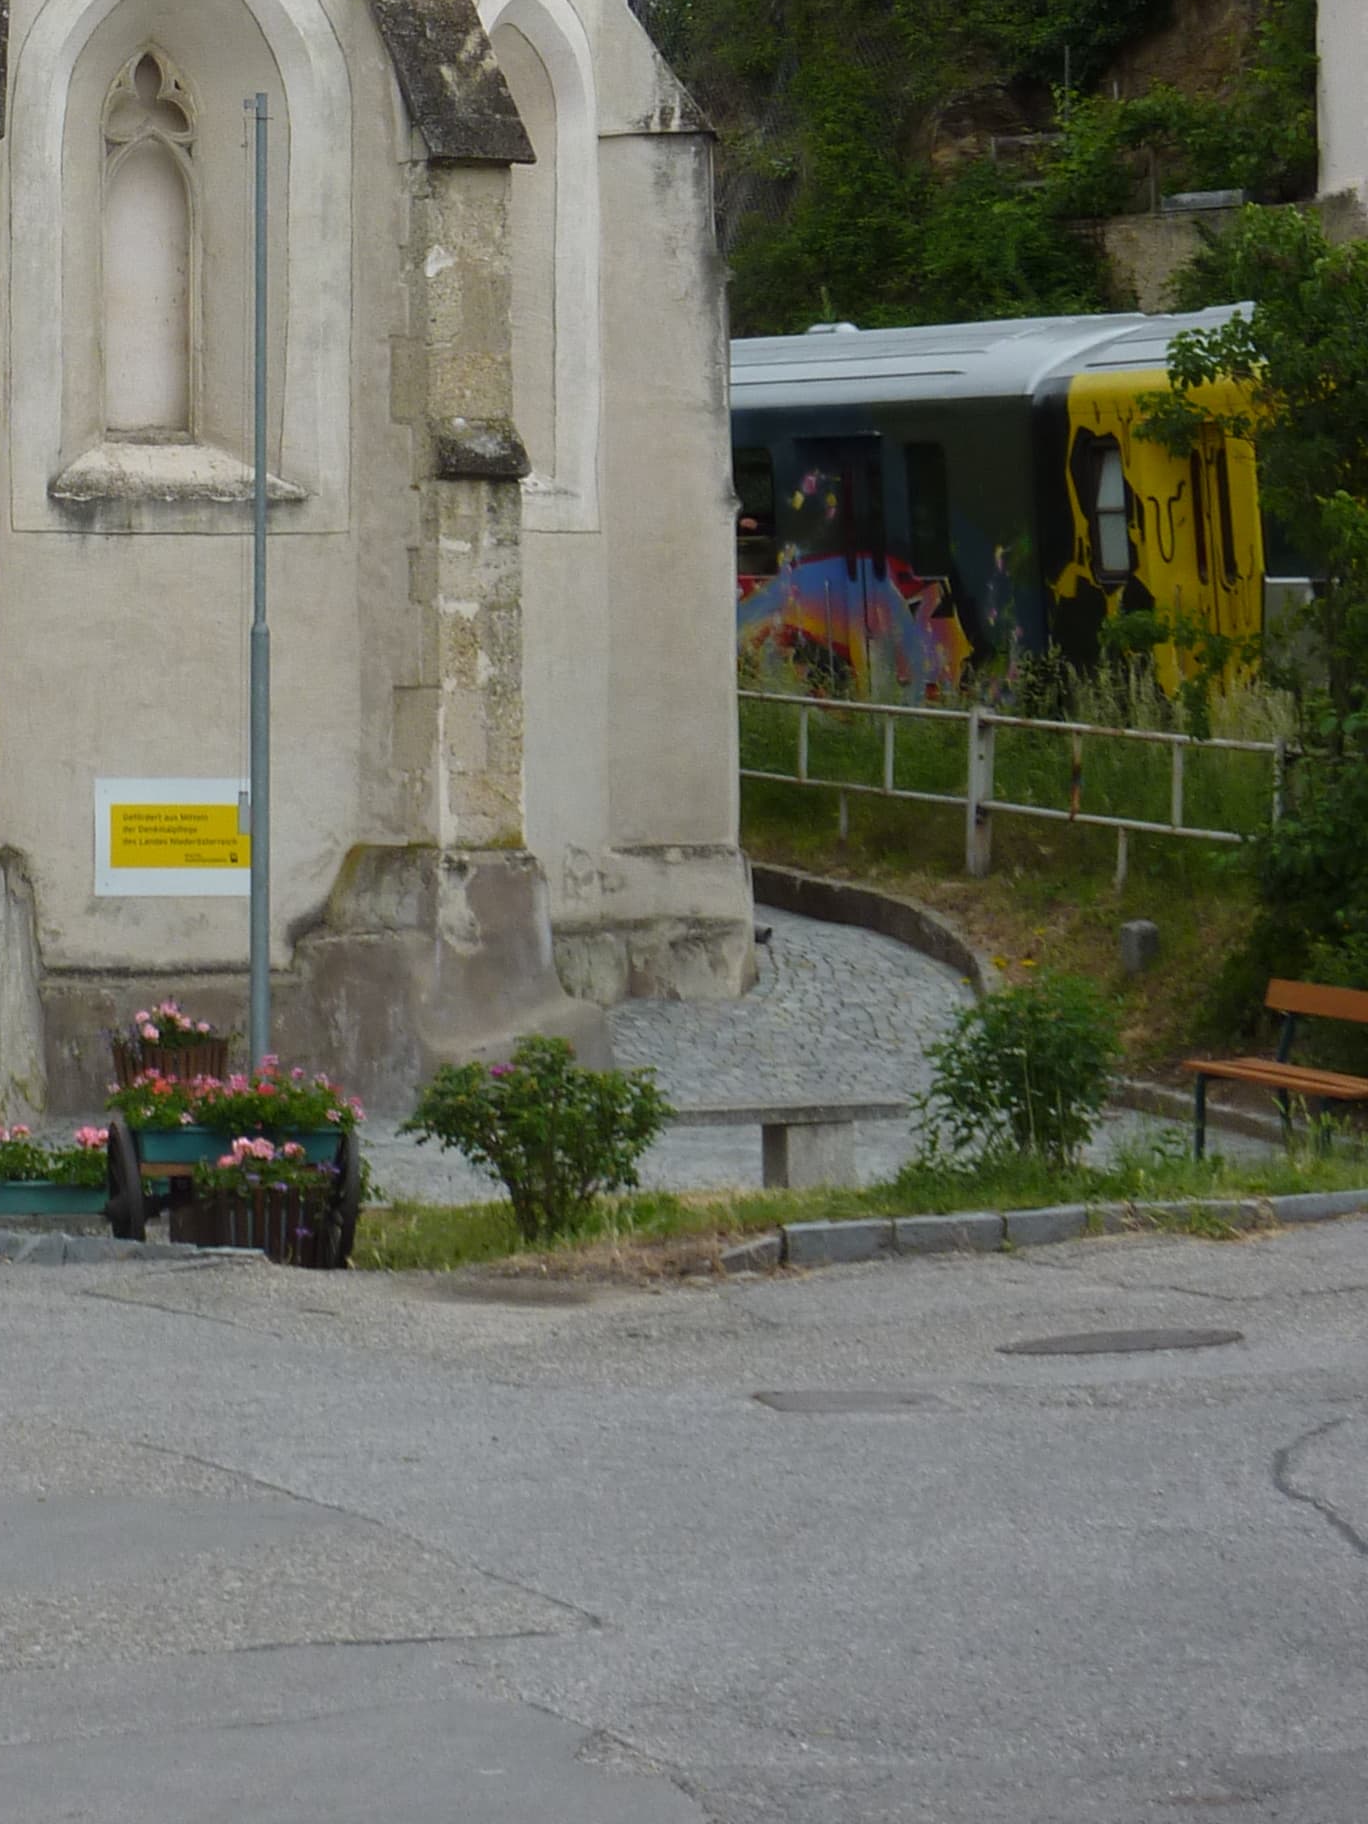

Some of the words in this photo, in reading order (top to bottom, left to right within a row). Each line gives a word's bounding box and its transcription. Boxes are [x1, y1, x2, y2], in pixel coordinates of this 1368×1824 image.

[164, 814, 178, 822] aus
[122, 825, 136, 833] der
[122, 838, 137, 846] des
[139, 838, 168, 846] Landes
